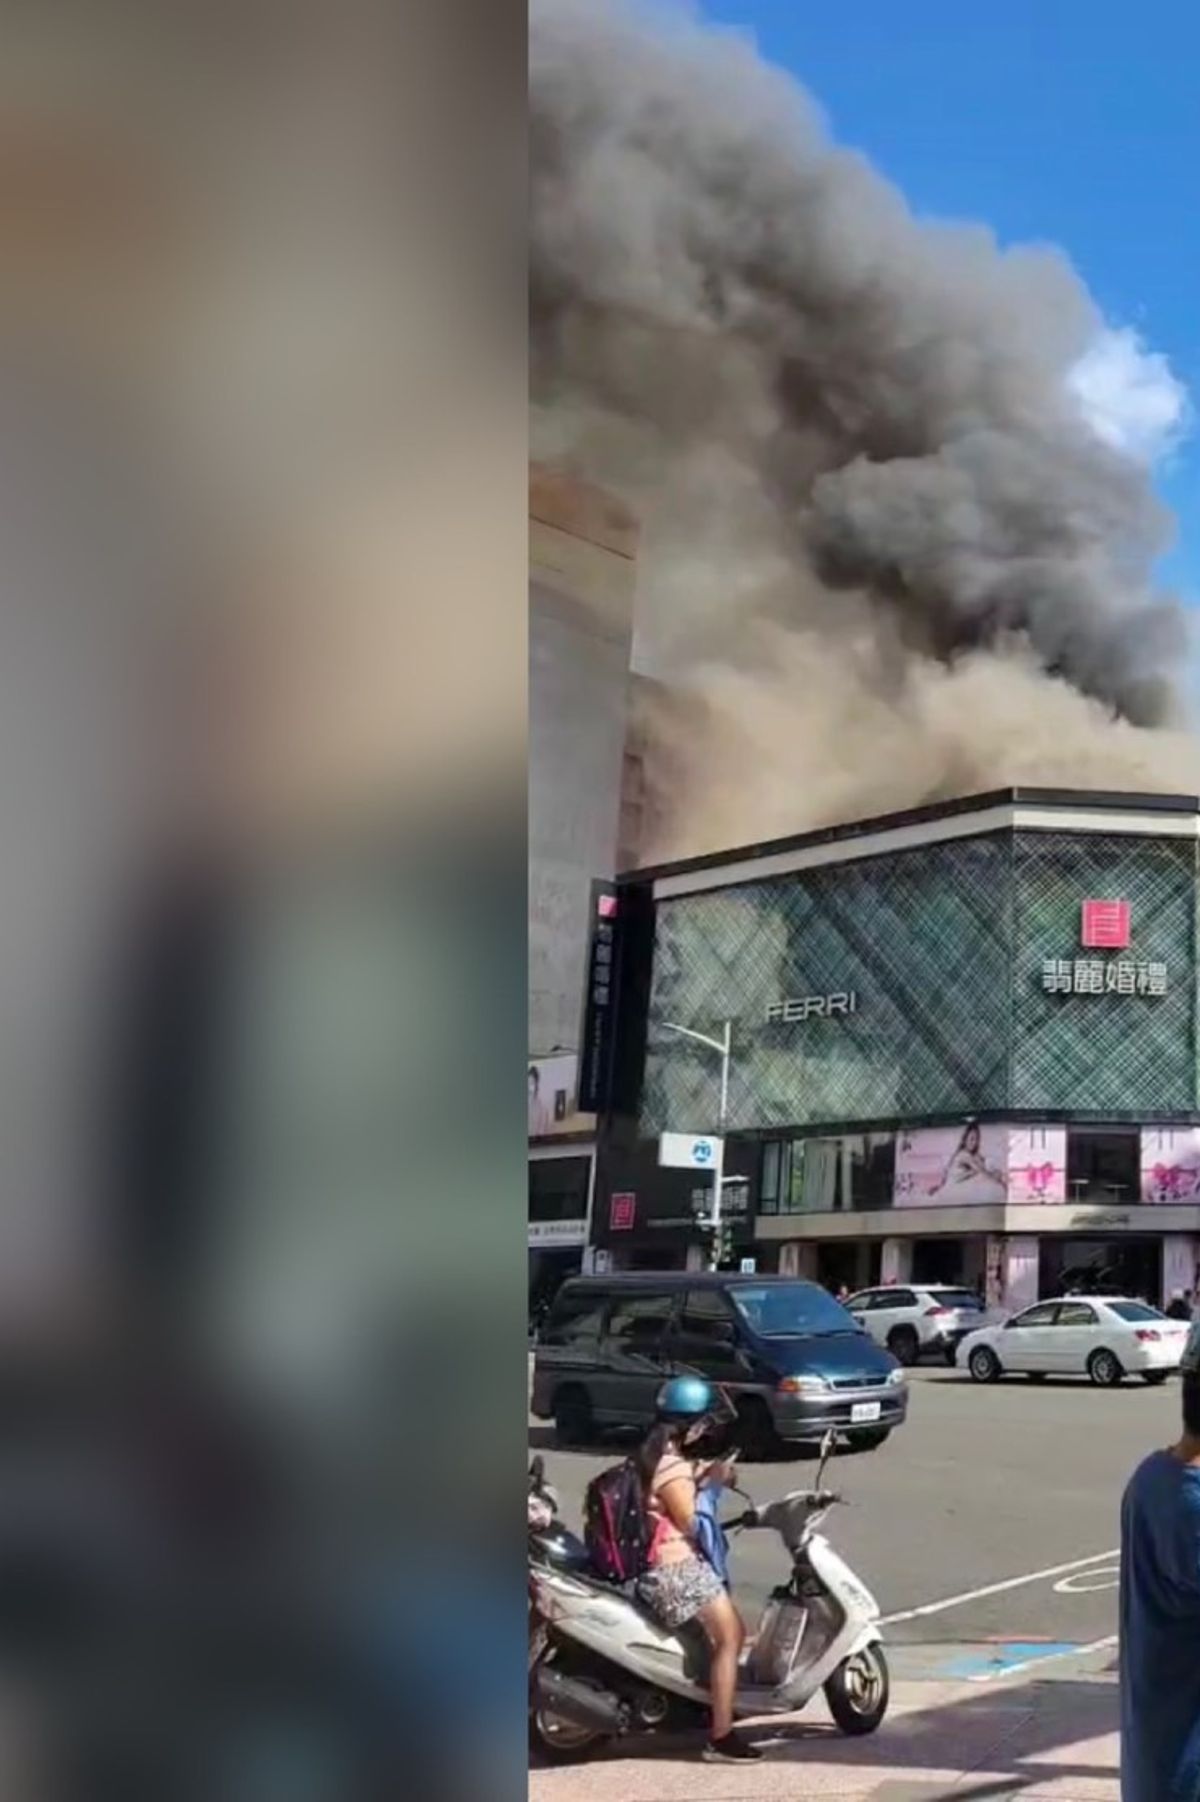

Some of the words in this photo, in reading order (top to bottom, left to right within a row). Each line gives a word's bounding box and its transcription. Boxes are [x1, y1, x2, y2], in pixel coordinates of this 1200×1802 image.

[1042, 960, 1167, 995] 翡麗婚禮
[765, 991, 856, 1023] FERRI
